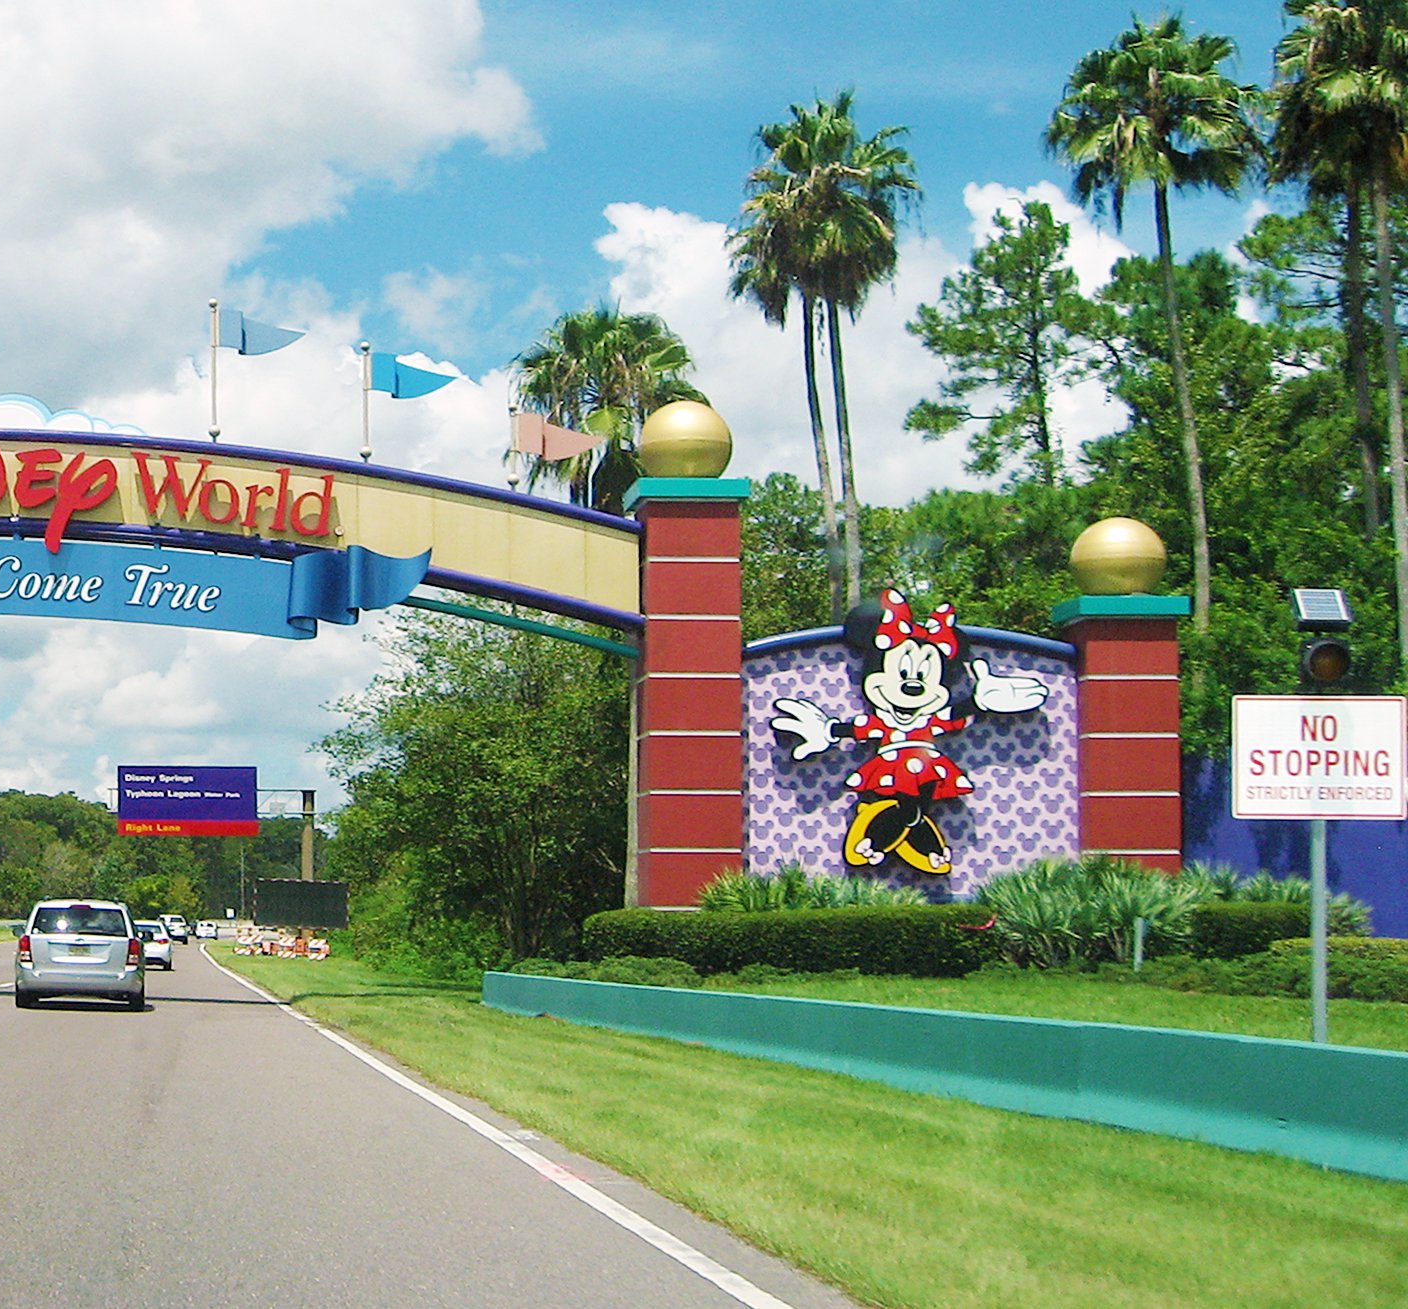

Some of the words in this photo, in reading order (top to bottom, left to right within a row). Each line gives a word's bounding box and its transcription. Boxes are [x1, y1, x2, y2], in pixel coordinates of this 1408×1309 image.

[132, 451, 335, 537] World
[124, 563, 221, 612] True
[1300, 714, 1338, 742] NO
[1249, 749, 1391, 777] STOPPING
[124, 774, 156, 783] Disney
[159, 774, 194, 783] Springs
[125, 789, 164, 798] Typhoon
[167, 790, 201, 799] Lagoon
[1246, 785, 1314, 801] STRICTLY
[1317, 785, 1394, 801] ENFORCED
[125, 823, 153, 833] Right
[157, 823, 181, 832] Lane
